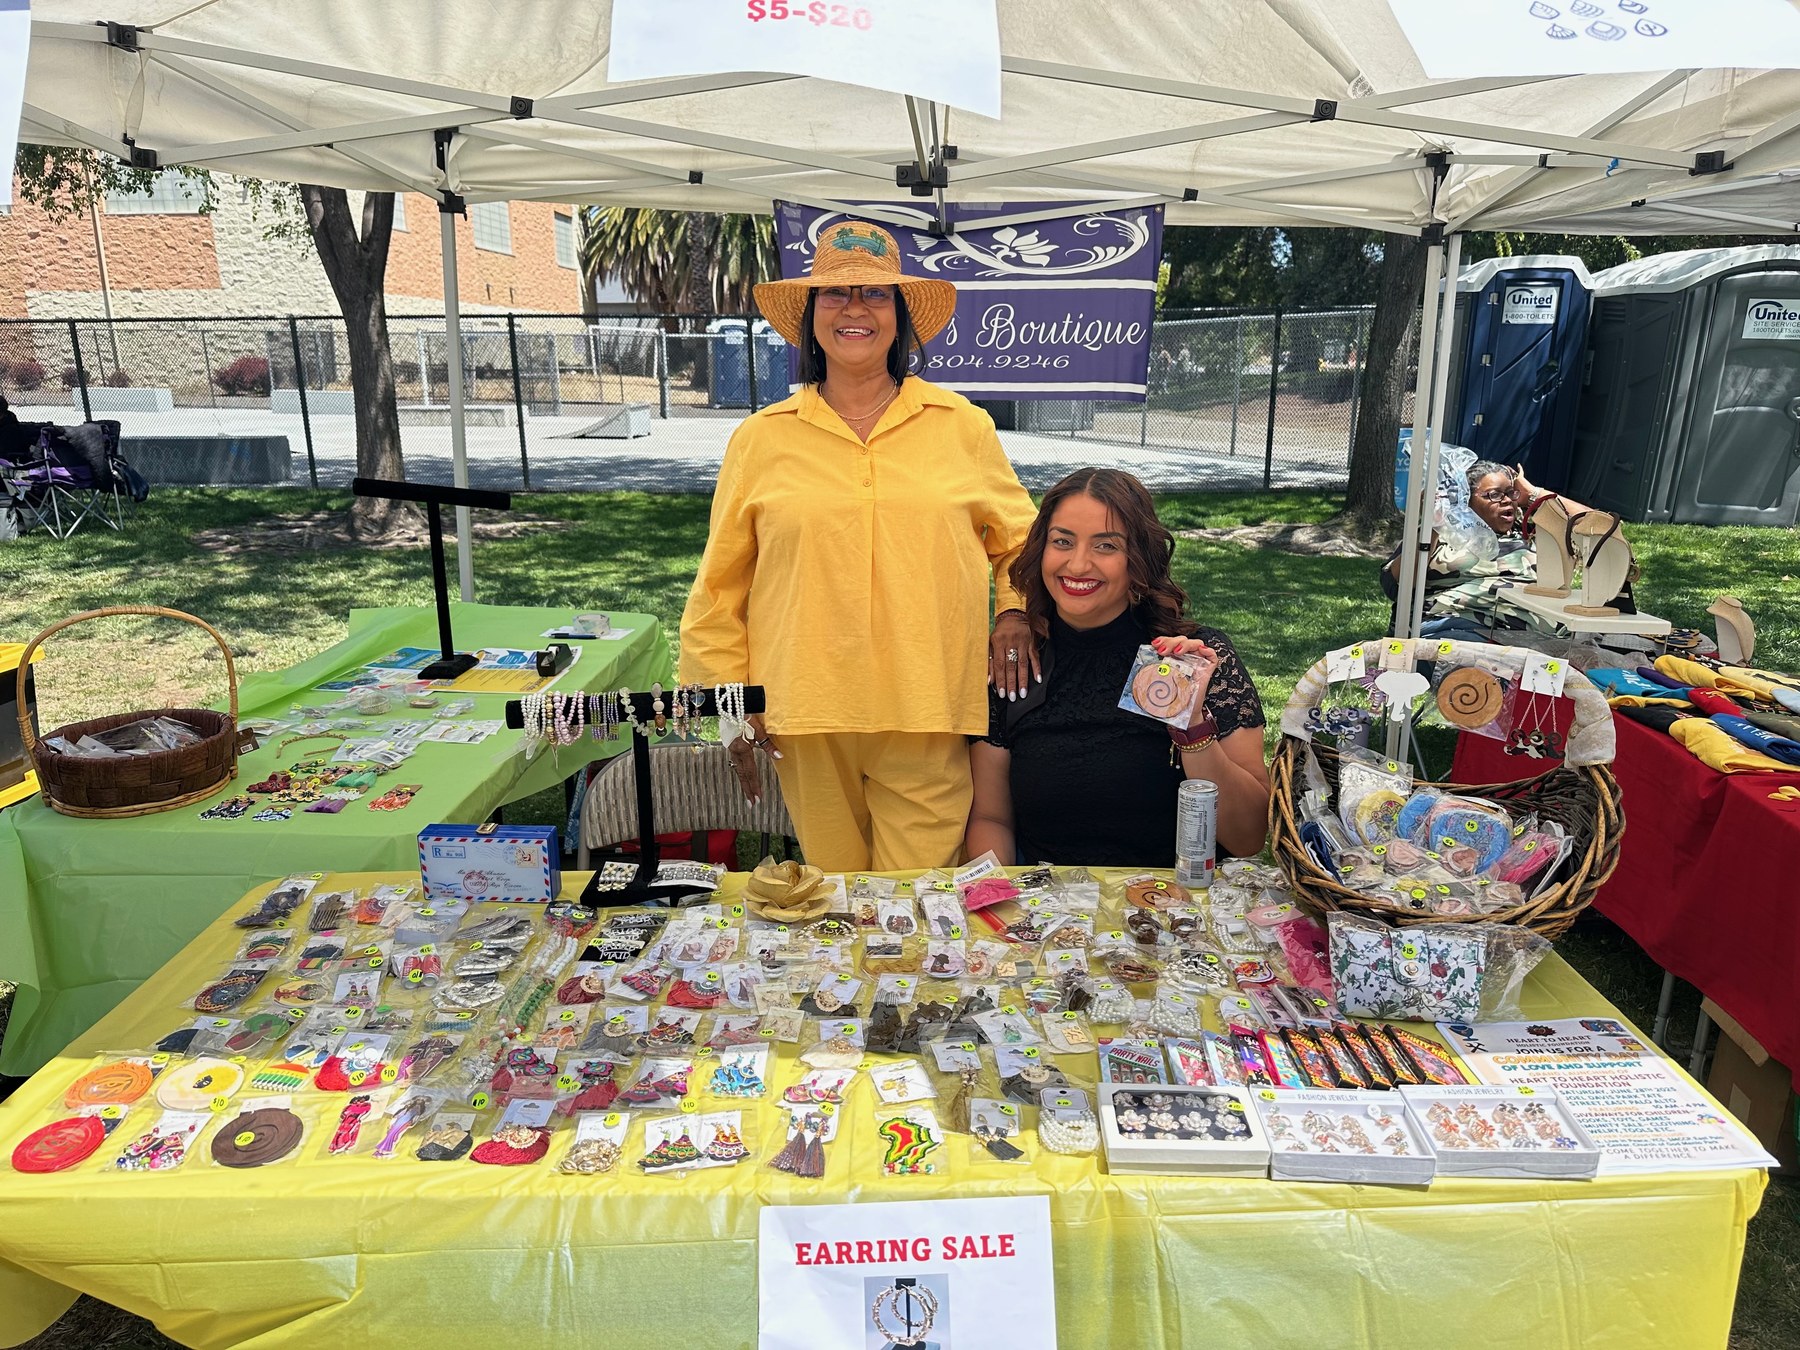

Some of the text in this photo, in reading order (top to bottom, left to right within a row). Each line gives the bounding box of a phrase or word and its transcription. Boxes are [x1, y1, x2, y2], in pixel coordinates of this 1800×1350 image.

[747, 0, 873, 31] $5-$20
[1512, 294, 1553, 305] United
[975, 303, 1147, 351] Boutique
[434, 848, 441, 857] R
[1403, 946, 1414, 955] $15
[1110, 1047, 1161, 1068] PARTY NAILS
[1492, 1051, 1641, 1065] COMMUNITY DAY
[1520, 1063, 1554, 1071] LOVE
[1556, 1062, 1584, 1070] AND
[1584, 1061, 1643, 1069] SUPPORT
[351, 1072, 365, 1082] $10
[384, 1069, 395, 1078] $10
[1509, 1077, 1547, 1085] HEART
[1571, 1074, 1606, 1083] HEART
[1608, 1073, 1666, 1081] HOLISTIC
[1552, 1081, 1632, 1089] FOUNDATION
[213, 1097, 224, 1107] $10
[1297, 1093, 1327, 1101] FASHION
[795, 1234, 1016, 1266] EARRING SALE
